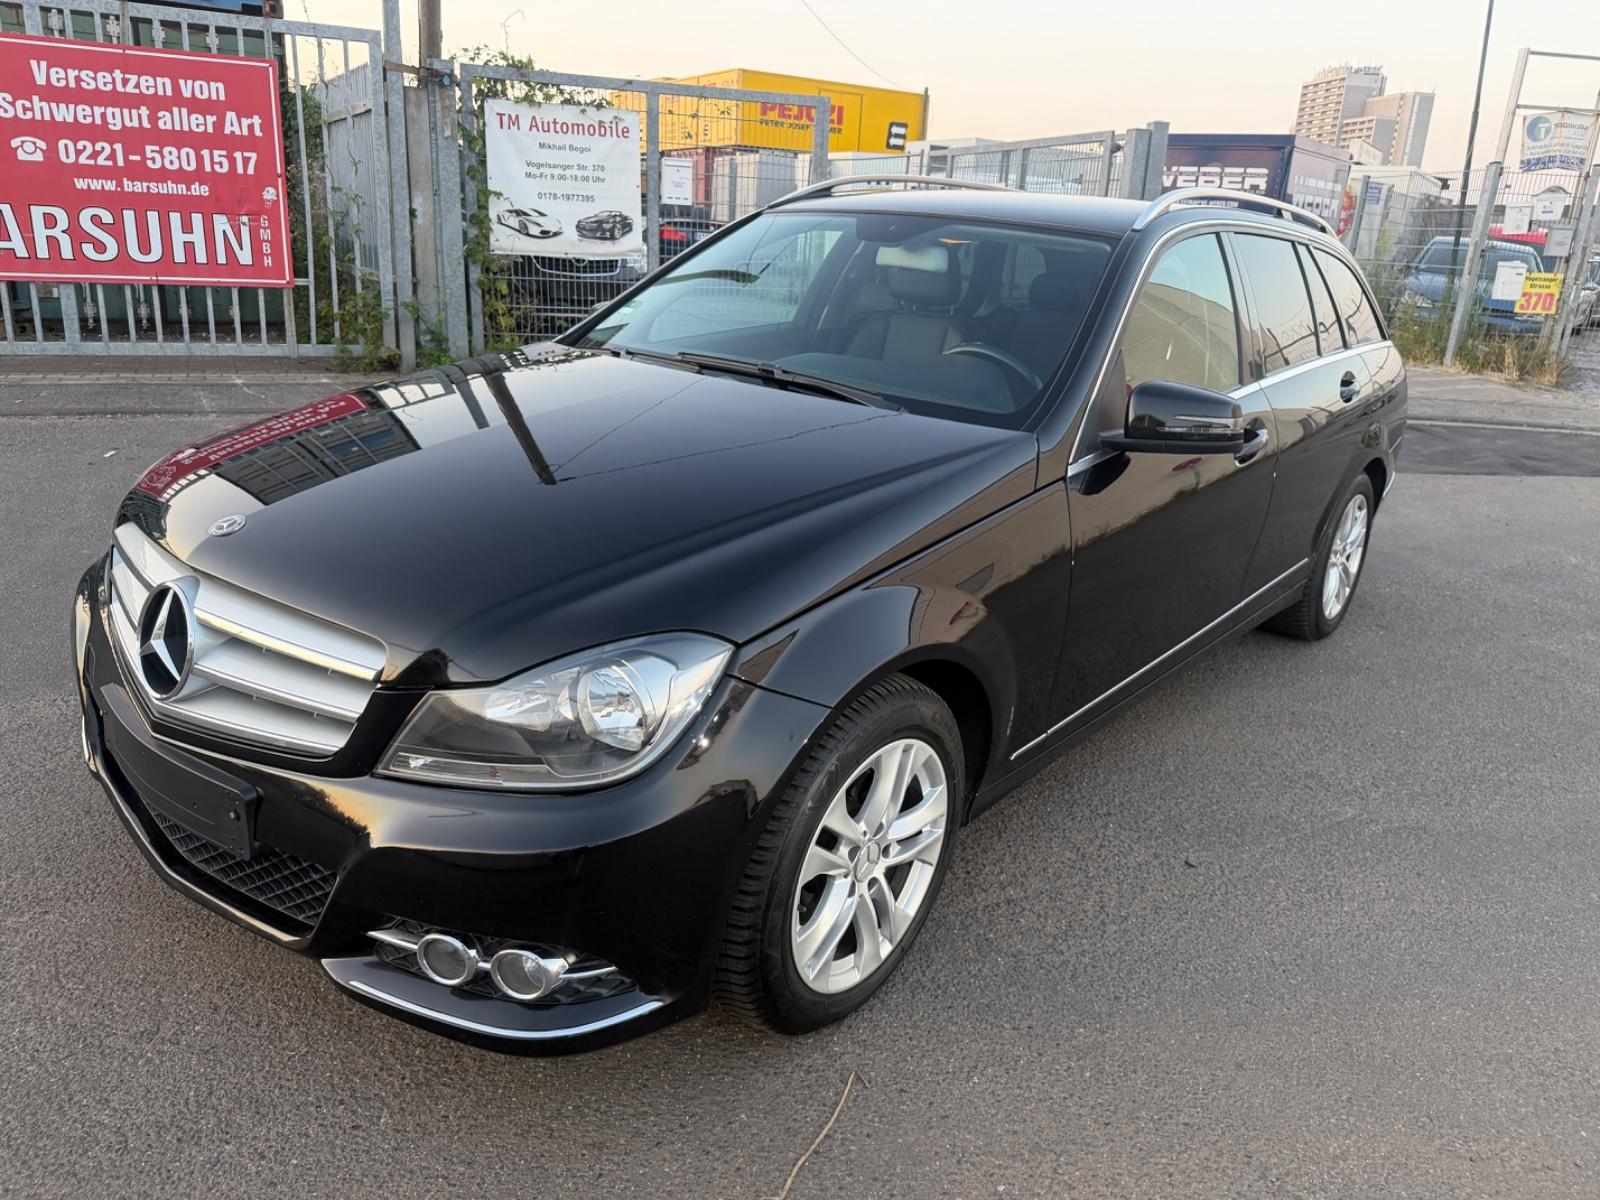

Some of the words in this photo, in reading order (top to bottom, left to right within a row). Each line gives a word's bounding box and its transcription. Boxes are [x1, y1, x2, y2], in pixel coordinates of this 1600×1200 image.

[29, 59, 173, 97] Versetzen
[178, 79, 226, 101] von
[0, 92, 151, 130] Schwergut
[157, 107, 217, 133] aller
[223, 111, 263, 137] Art
[496, 112, 521, 132] TM
[529, 115, 631, 139] Automobile
[538, 142, 567, 153] Mikhail
[525, 160, 575, 171] Vogelsanger
[576, 162, 590, 172] Str.
[592, 163, 606, 173] 370
[74, 177, 210, 197] www.barsuhn.de
[525, 172, 549, 181] Mo-Fr
[550, 173, 590, 183] 9:00-18:00
[592, 174, 606, 184] Uhr
[537, 191, 596, 203] 0178-1977395
[1519, 292, 1555, 311] 370
